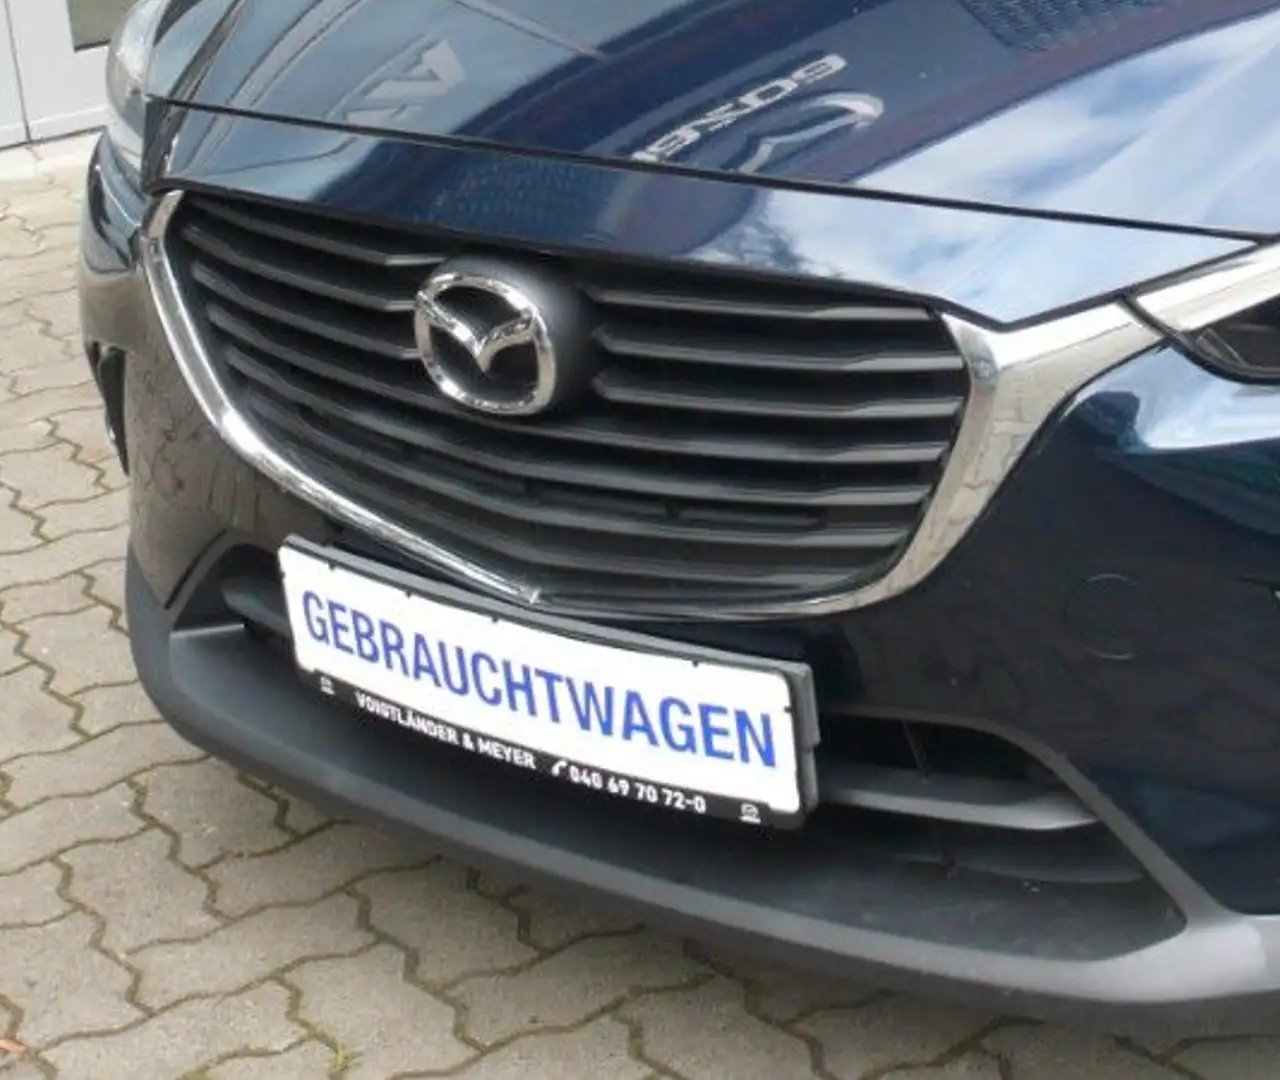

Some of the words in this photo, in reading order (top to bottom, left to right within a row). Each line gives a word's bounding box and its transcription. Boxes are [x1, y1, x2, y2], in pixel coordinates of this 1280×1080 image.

[301, 589, 776, 768] GEBRAUCHTWAGEN
[354, 689, 459, 746] VOIGTLÄNDER
[462, 732, 475, 752] &
[477, 736, 537, 769] MEYER
[569, 764, 603, 789] 040
[607, 776, 630, 796] 69
[634, 782, 658, 803] 70
[662, 789, 707, 814] 72-0
